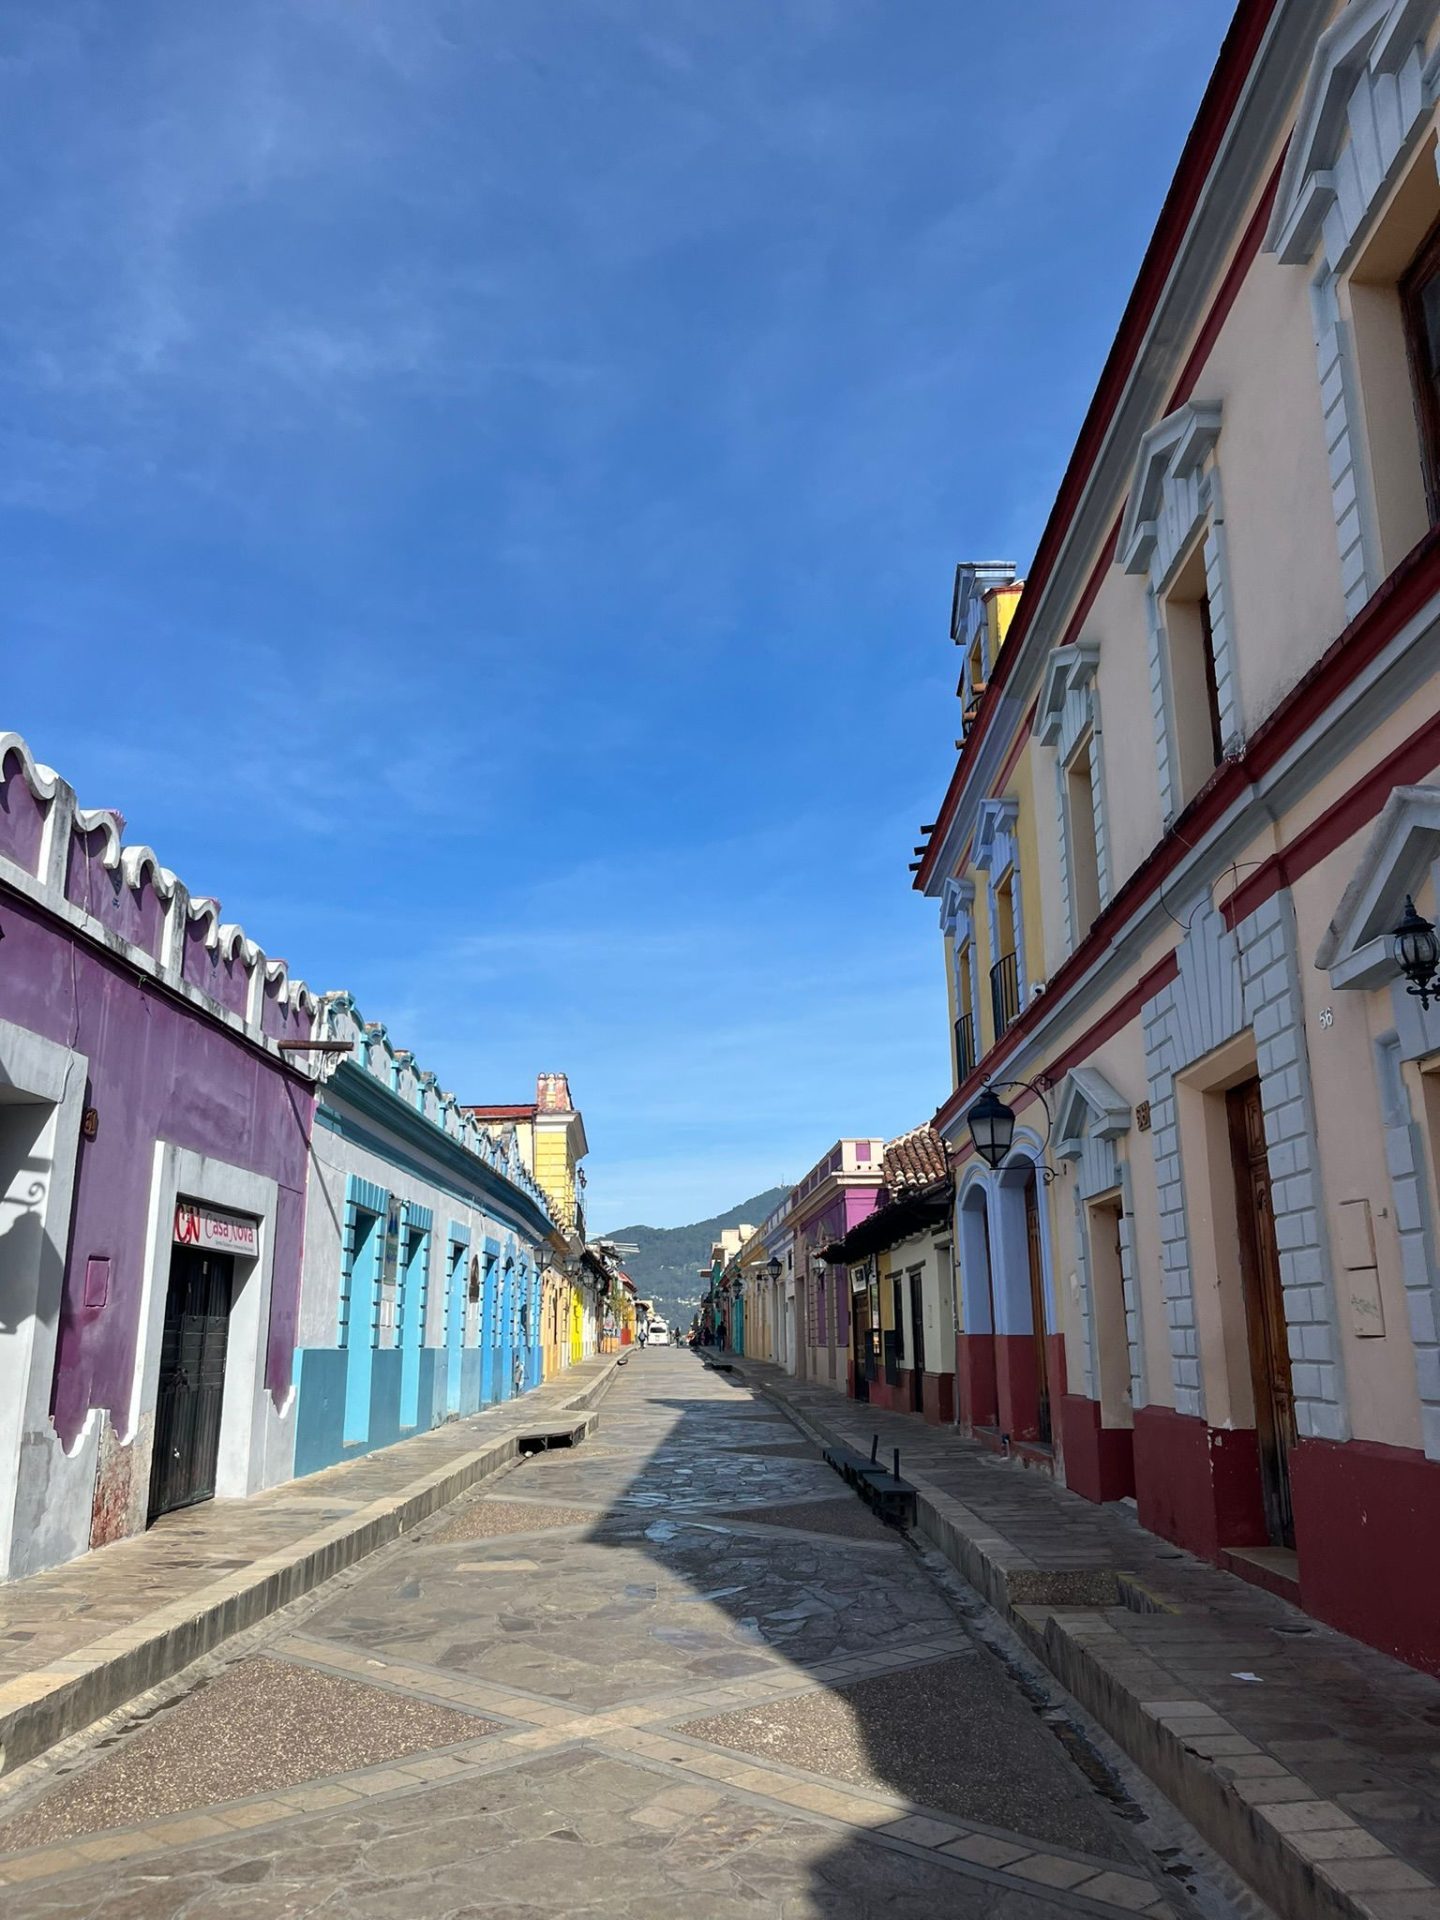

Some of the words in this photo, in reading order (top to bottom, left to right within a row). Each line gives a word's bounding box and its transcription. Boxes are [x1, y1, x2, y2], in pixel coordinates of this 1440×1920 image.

[1319, 1007, 1333, 1029] 56
[205, 1213, 228, 1239] Casa
[229, 1219, 254, 1243] Nova
